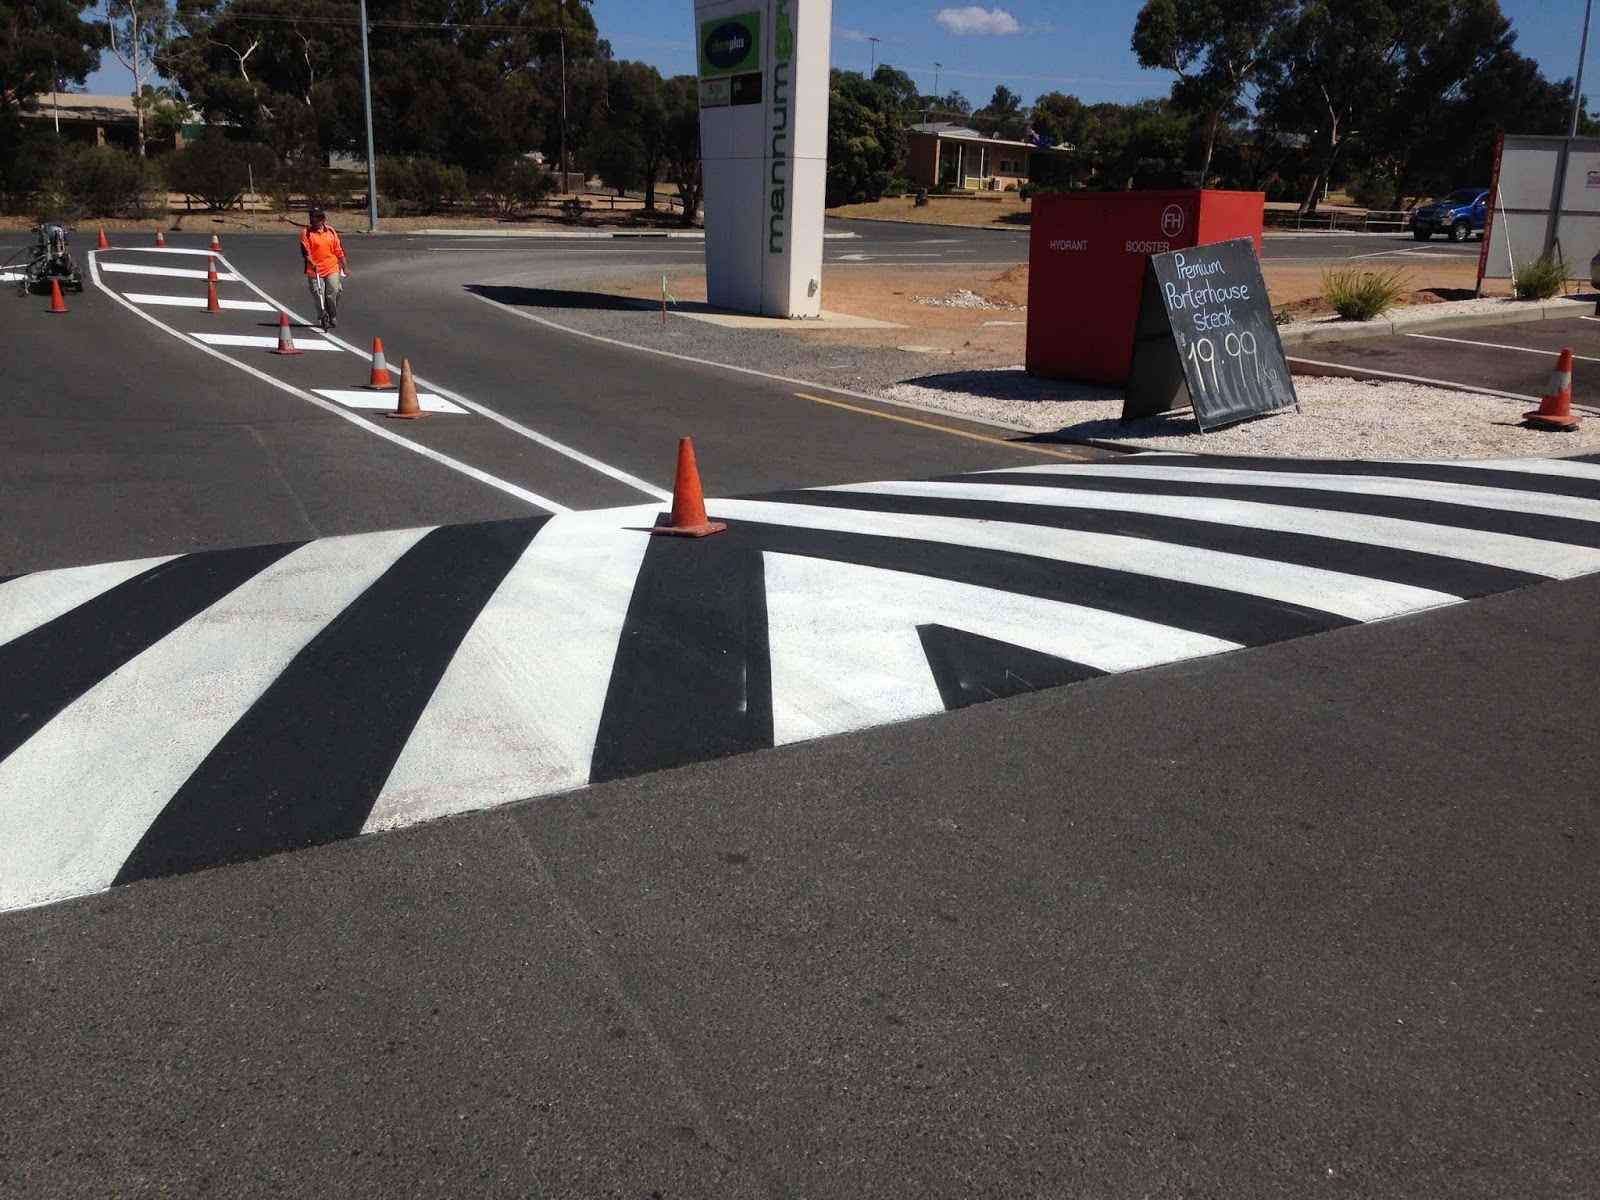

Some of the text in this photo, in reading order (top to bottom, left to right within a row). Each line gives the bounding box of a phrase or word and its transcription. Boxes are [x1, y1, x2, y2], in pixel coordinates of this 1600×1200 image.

[1164, 213, 1181, 229] FH
[1049, 239, 1170, 253] HYDRANT BOOSTER
[1174, 253, 1226, 280] Premium
[1165, 279, 1251, 311] Porterhouse
